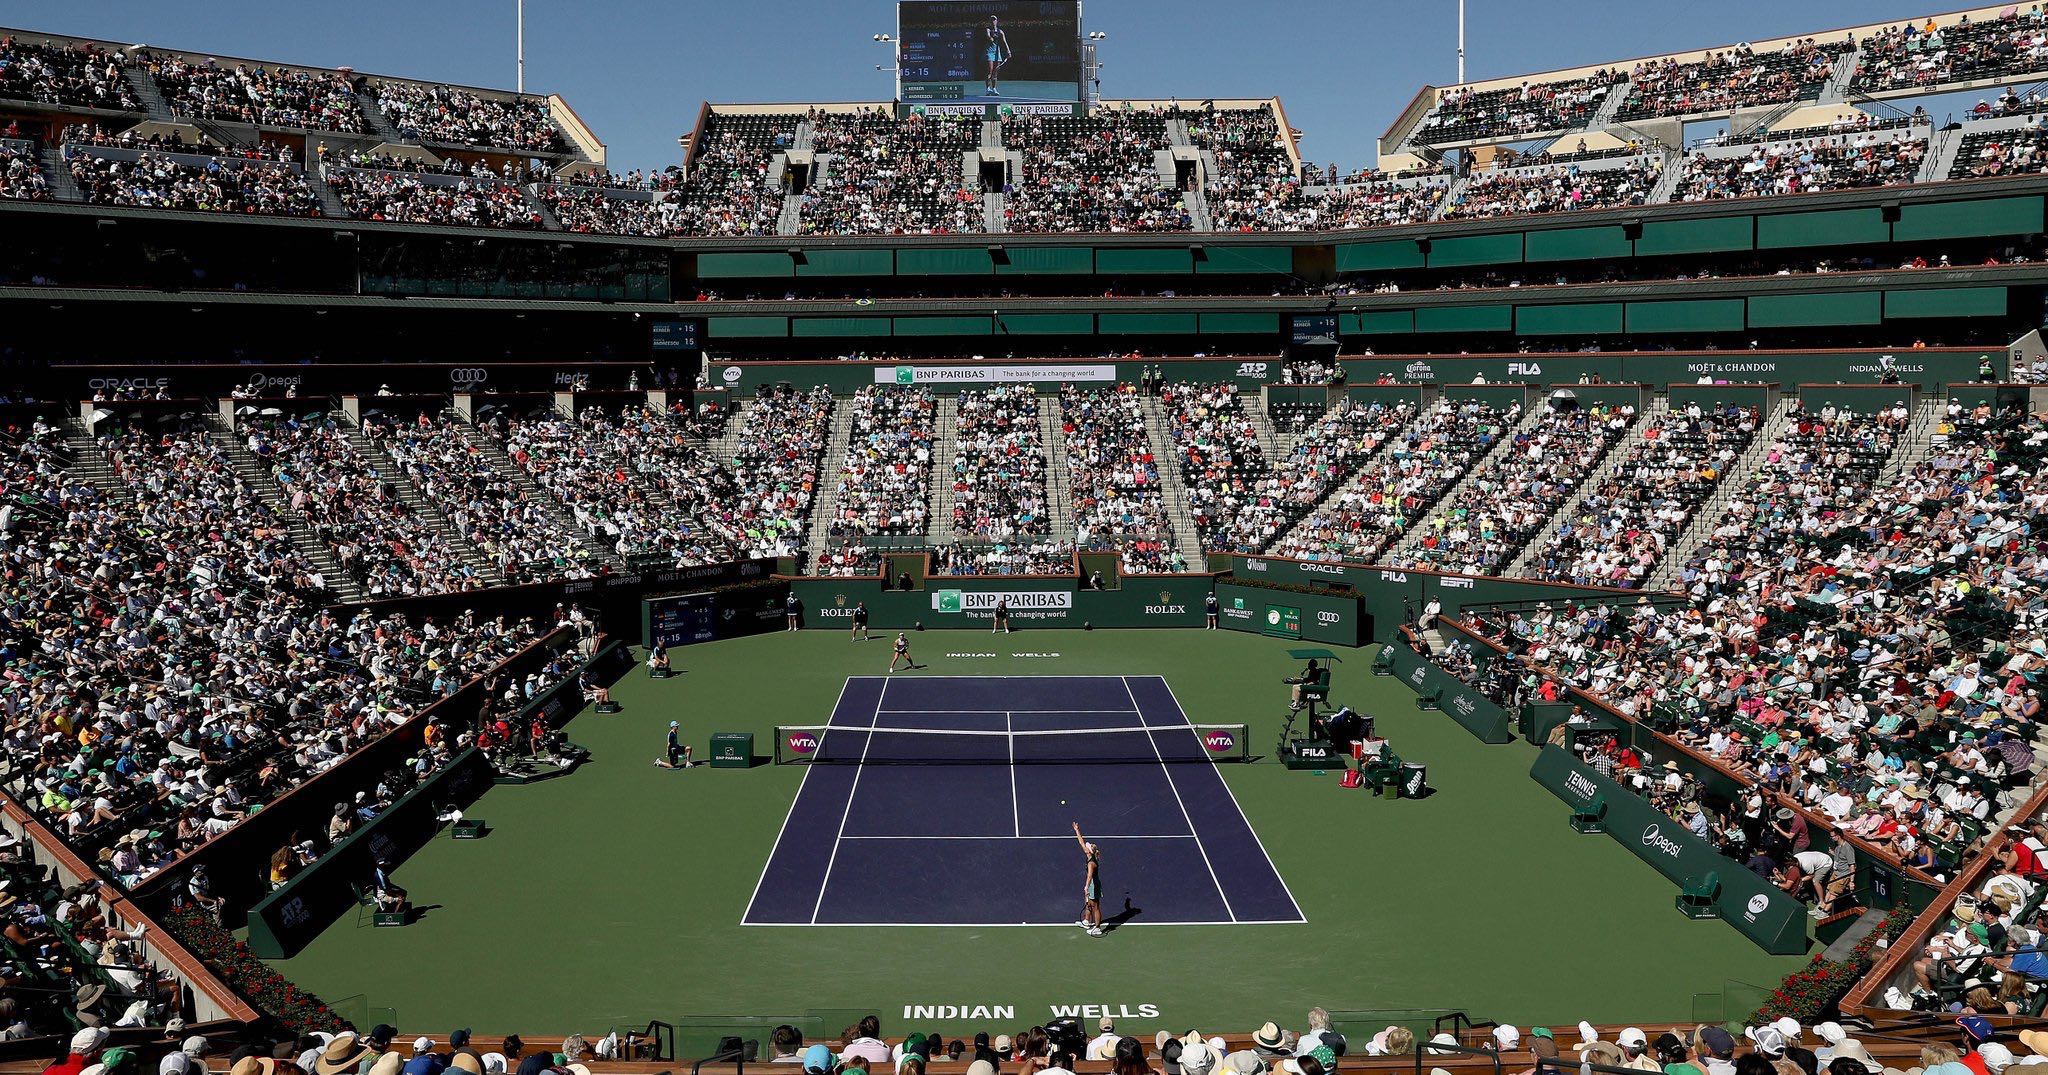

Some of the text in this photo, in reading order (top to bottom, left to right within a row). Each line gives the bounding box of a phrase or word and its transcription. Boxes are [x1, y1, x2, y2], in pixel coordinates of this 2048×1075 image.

[918, 68, 929, 76] 15
[1237, 362, 1267, 373] ATP
[1406, 363, 1431, 373] Corona
[1508, 363, 1541, 375] FILA
[1725, 363, 1775, 372] CHANDON
[555, 372, 589, 384] Hertz
[916, 370, 985, 379] BNP PARIBAS
[1031, 370, 1040, 378] for
[1047, 369, 1075, 378] changing
[89, 378, 168, 389] ORACLE
[268, 375, 301, 391] pepsi
[686, 567, 722, 578] CHANDON
[1300, 563, 1344, 574] ORACLE
[1381, 570, 1407, 583] FILA
[1440, 576, 1473, 588] ESPN
[966, 593, 1065, 607] BNP PARIBAS
[1145, 605, 1186, 613] ROLEX
[1015, 611, 1045, 619] changing
[790, 739, 816, 747] WTA
[1206, 737, 1233, 746] WTA
[1302, 748, 1326, 757] FILA
[1567, 770, 1597, 796] TENNIS
[1652, 835, 1682, 858] pepsi
[1875, 880, 1886, 896] 16
[172, 894, 182, 907] 16
[903, 1003, 1160, 1019] INDIAN WELLS
